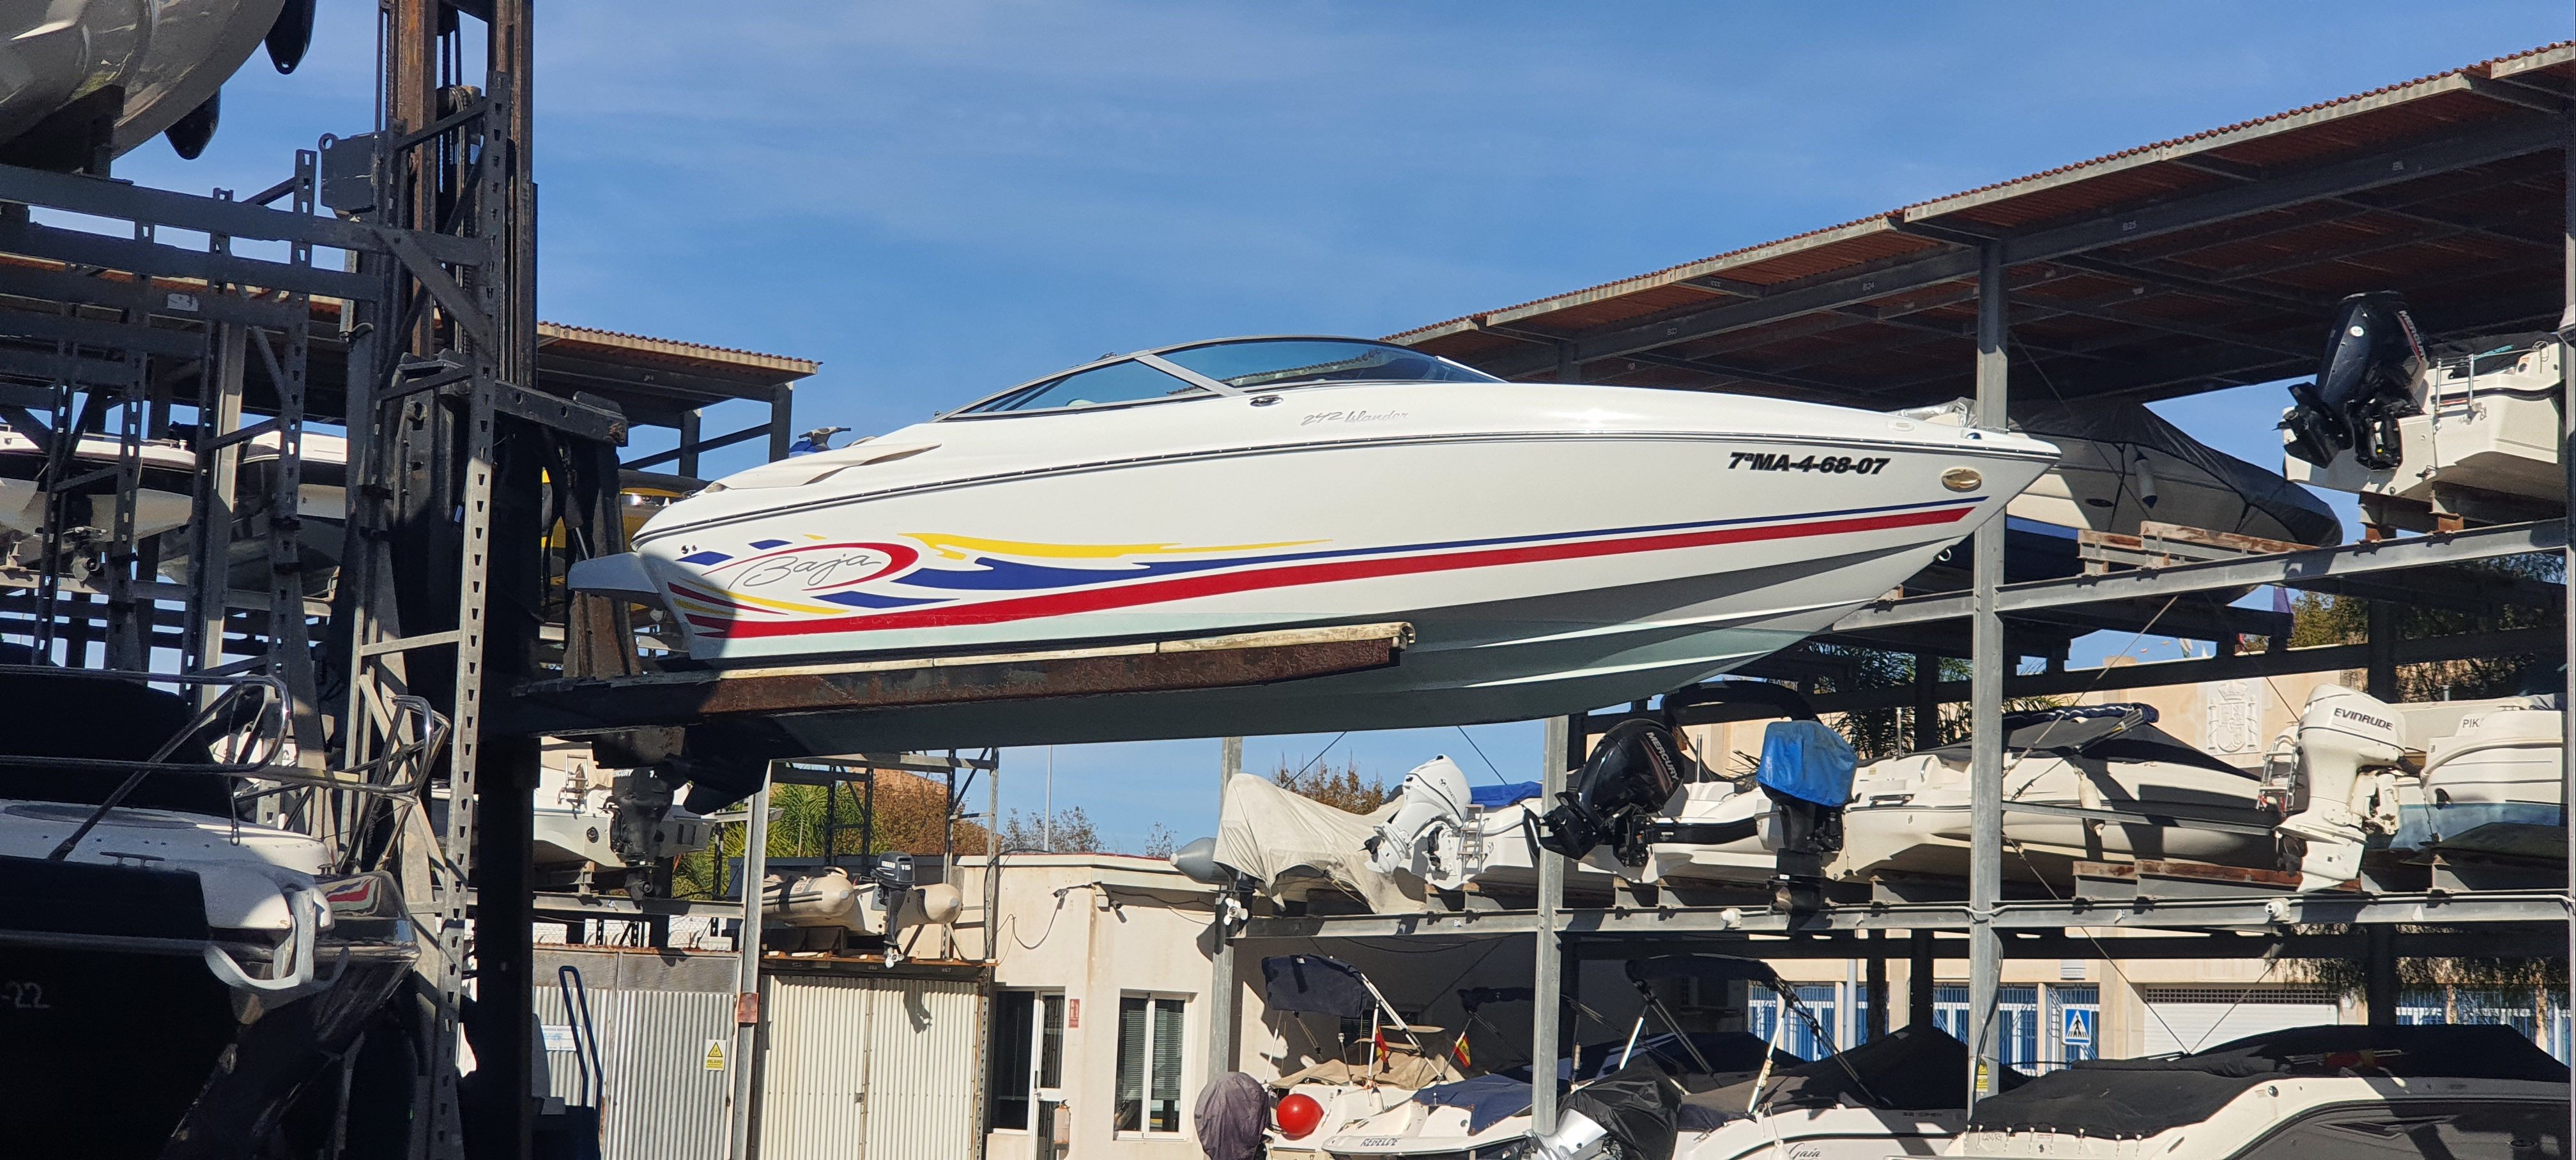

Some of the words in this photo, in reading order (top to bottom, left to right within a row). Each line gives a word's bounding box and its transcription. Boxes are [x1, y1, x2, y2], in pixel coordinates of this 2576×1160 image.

[1301, 411, 1344, 426] 242
[1344, 410, 1409, 423] Islander
[727, 553, 882, 587] Baja
[2333, 707, 2394, 731] EVINRUDE
[1645, 731, 1680, 780] MERCURY
[613, 768, 634, 777] ERCURY
[1789, 1143, 1822, 1160] Gaia
